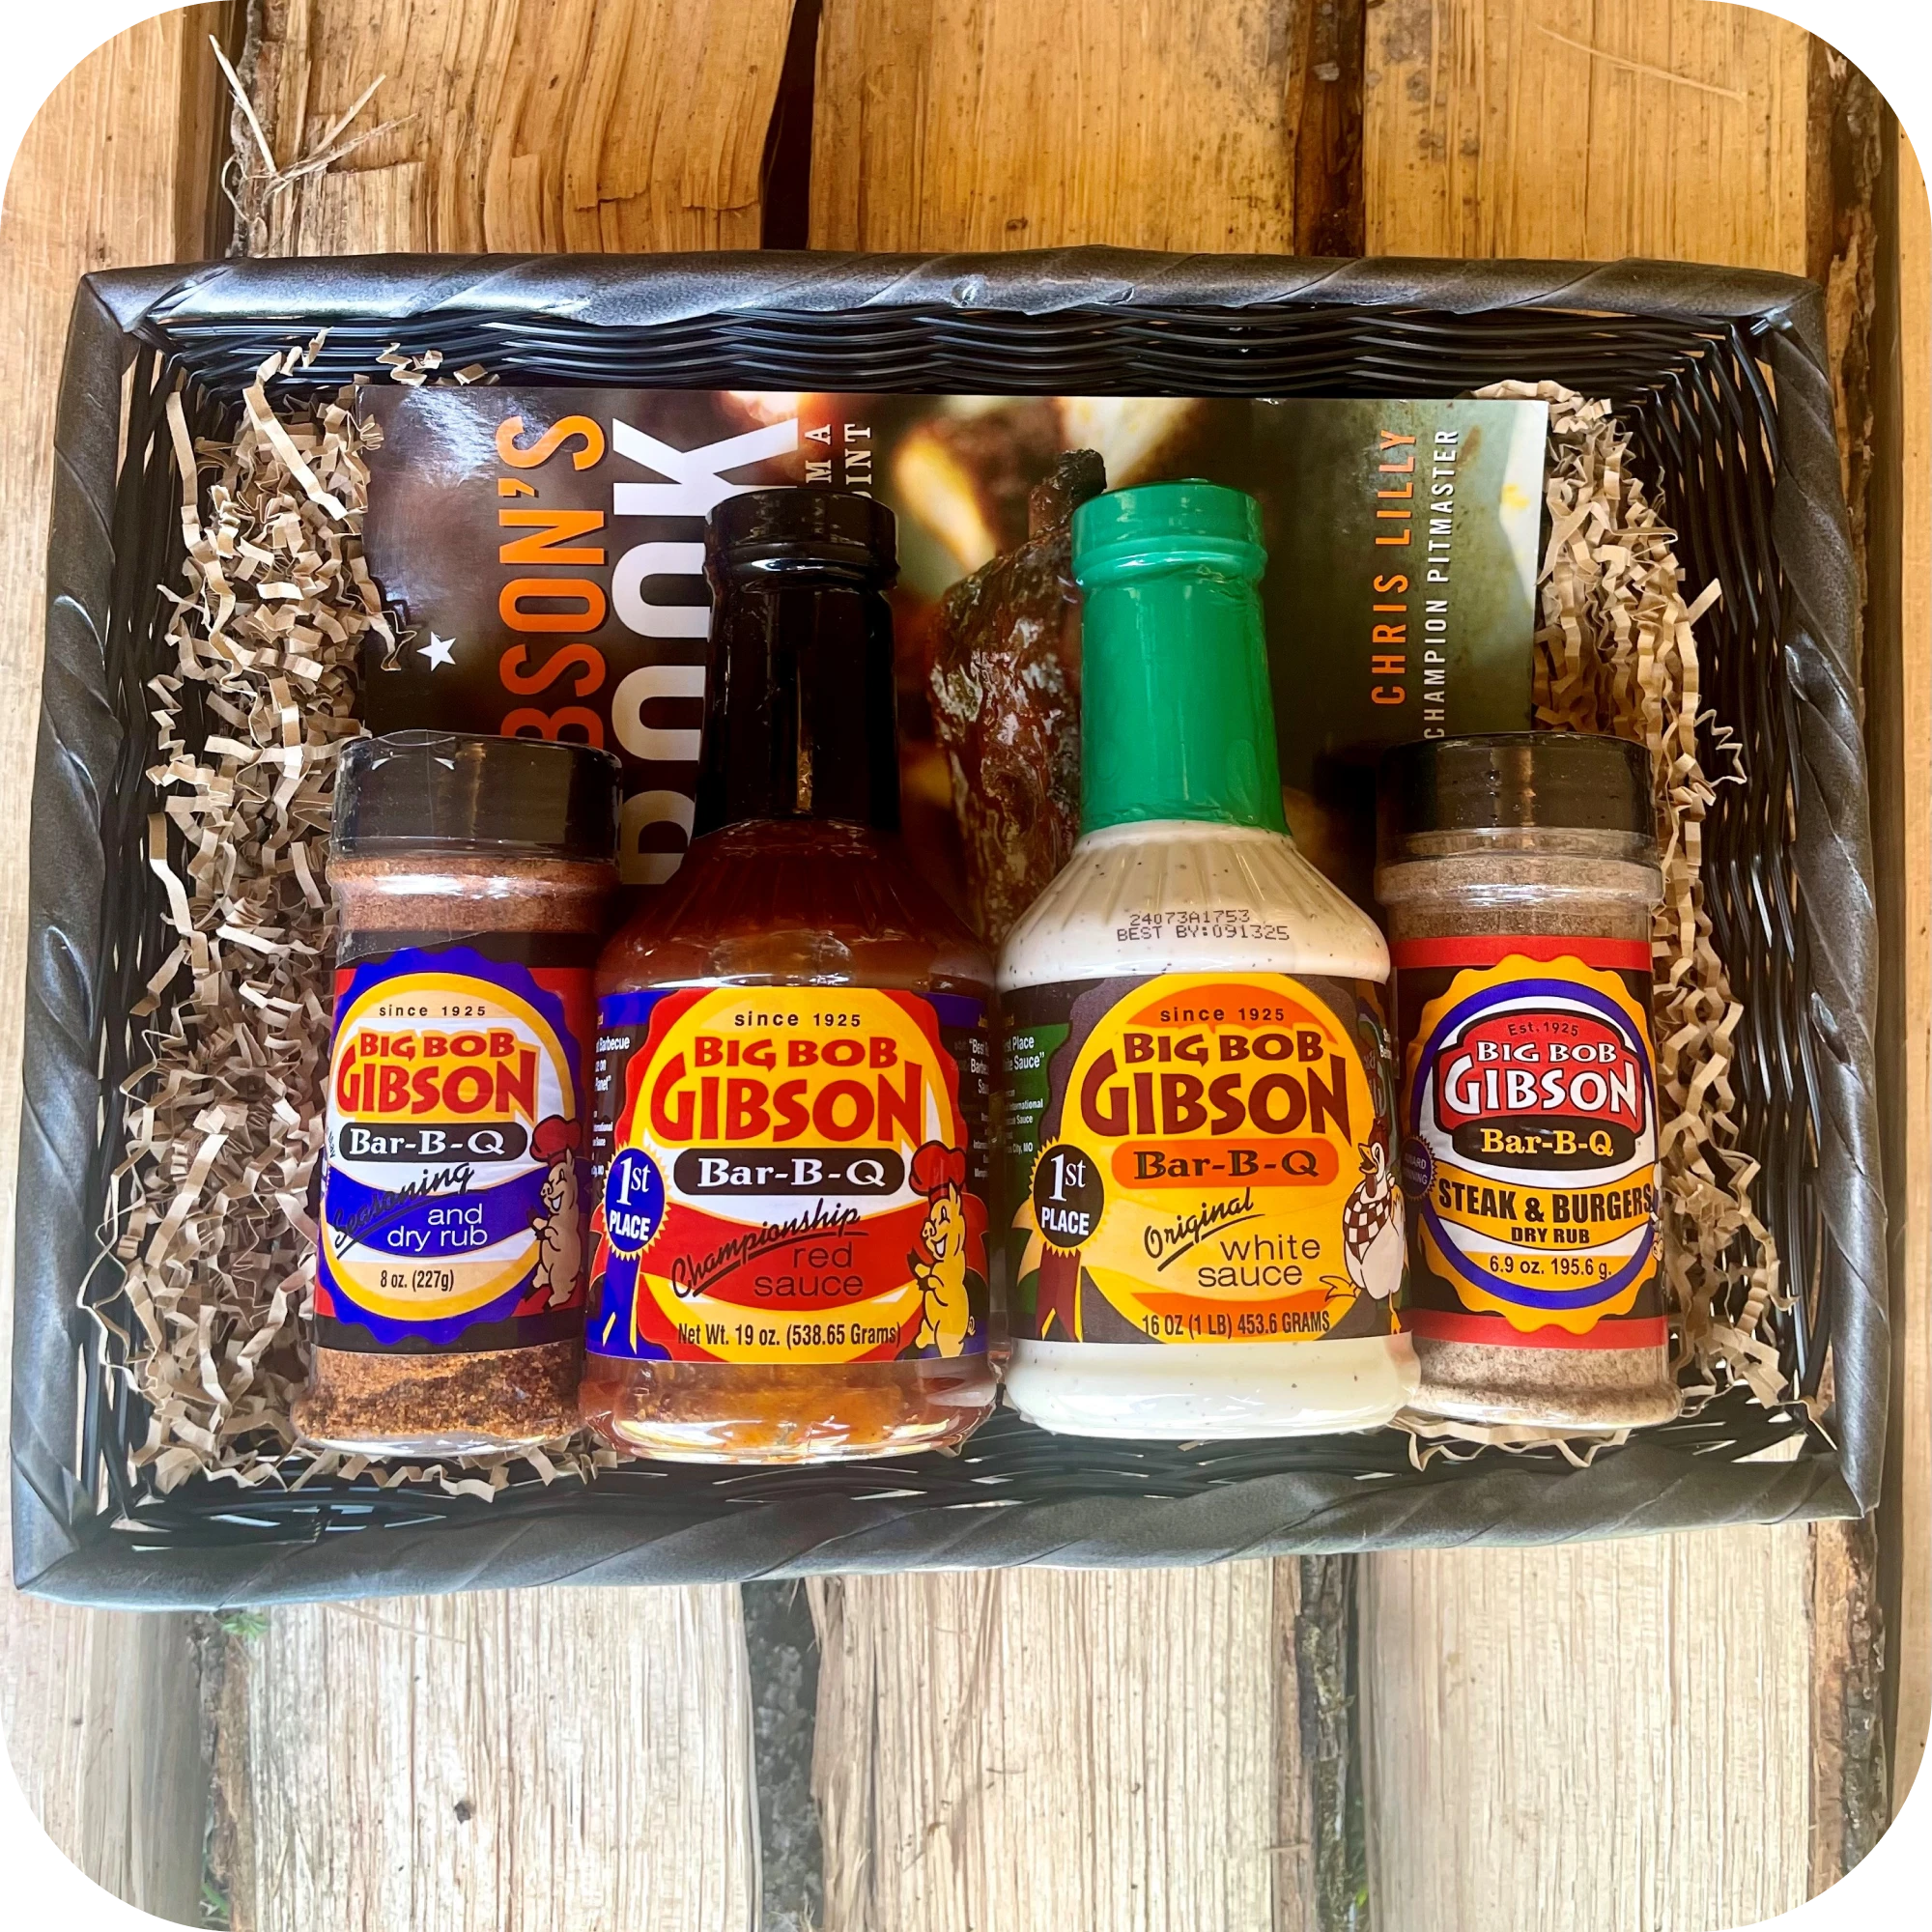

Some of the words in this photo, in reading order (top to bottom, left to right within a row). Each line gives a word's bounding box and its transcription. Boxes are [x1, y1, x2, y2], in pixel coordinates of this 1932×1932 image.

[1376, 429, 1416, 546] LILLY
[1426, 430, 1459, 583] PITMASTER
[1371, 574, 1409, 705] CHRIS
[1423, 599, 1448, 740] CHAMPION
[1129, 909, 1250, 927] 24073A1753
[1117, 925, 1163, 942] BEST
[379, 1005, 428, 1017] since
[441, 1006, 486, 1017] 1925
[734, 1009, 800, 1027] since
[812, 1012, 862, 1027] 1925
[1160, 1007, 1225, 1023] since
[1238, 1008, 1285, 1021] 1925
[1012, 1036, 1036, 1051] Place
[1507, 1022, 1540, 1037] Est.
[1543, 1021, 1580, 1037] 1925
[359, 1032, 416, 1063] BIG
[423, 1032, 515, 1059] BOB
[695, 1036, 777, 1072] BIG
[787, 1036, 898, 1069] BOB
[1122, 1033, 1209, 1067] BIG
[1218, 1030, 1324, 1063] BOB
[1477, 1040, 1540, 1063] BIG
[1549, 1042, 1618, 1064] BOB
[337, 1044, 536, 1122] GIBSON
[1444, 1054, 1637, 1120] GIBSON
[650, 1051, 923, 1148] GIBSON
[1080, 1048, 1352, 1148] GIBSON
[349, 1127, 505, 1156] Bar-B-Q
[1479, 1127, 1614, 1157] Bar-B-Q
[696, 1158, 887, 1187] Bar-B-Q
[1048, 1152, 1087, 1202] 1st
[1133, 1149, 1321, 1179] Bar-B-Q
[615, 1156, 651, 1207] 1st
[427, 1203, 483, 1227] and
[1437, 1178, 1518, 1221] STEAK
[1523, 1196, 1545, 1223] &
[1551, 1181, 1652, 1224] BURGERS
[609, 1209, 651, 1242] PLACE
[1040, 1207, 1091, 1236] PLACE
[1144, 1186, 1254, 1259] Original
[1510, 1226, 1548, 1243] DRY
[1552, 1228, 1591, 1244] RUB
[386, 1225, 432, 1253] dry
[440, 1225, 489, 1247] rub
[671, 1197, 862, 1298] Championship
[1220, 1234, 1321, 1262] white
[793, 1241, 854, 1268] red
[1489, 1255, 1515, 1273] 6.9
[1520, 1260, 1546, 1275] oz.
[1549, 1258, 1594, 1276] 195.6
[1598, 1262, 1612, 1280] g.
[380, 1269, 387, 1289] 8
[390, 1273, 408, 1289] oz.
[412, 1268, 455, 1293] (227g)
[753, 1274, 864, 1297] sauce
[1197, 1264, 1303, 1288] sauce
[677, 1322, 701, 1345] Net
[705, 1323, 729, 1346] Wt.
[734, 1325, 754, 1346] 19
[758, 1329, 781, 1346] oz.
[785, 1323, 846, 1350] (538.65
[850, 1321, 901, 1349] Grams)
[1141, 1314, 1159, 1336] 16
[1164, 1314, 1184, 1335] OZ
[1188, 1314, 1202, 1340] (1
[1208, 1312, 1233, 1337] LB)
[1237, 1312, 1278, 1334] 453.6
[1282, 1310, 1331, 1333] GRAMS
